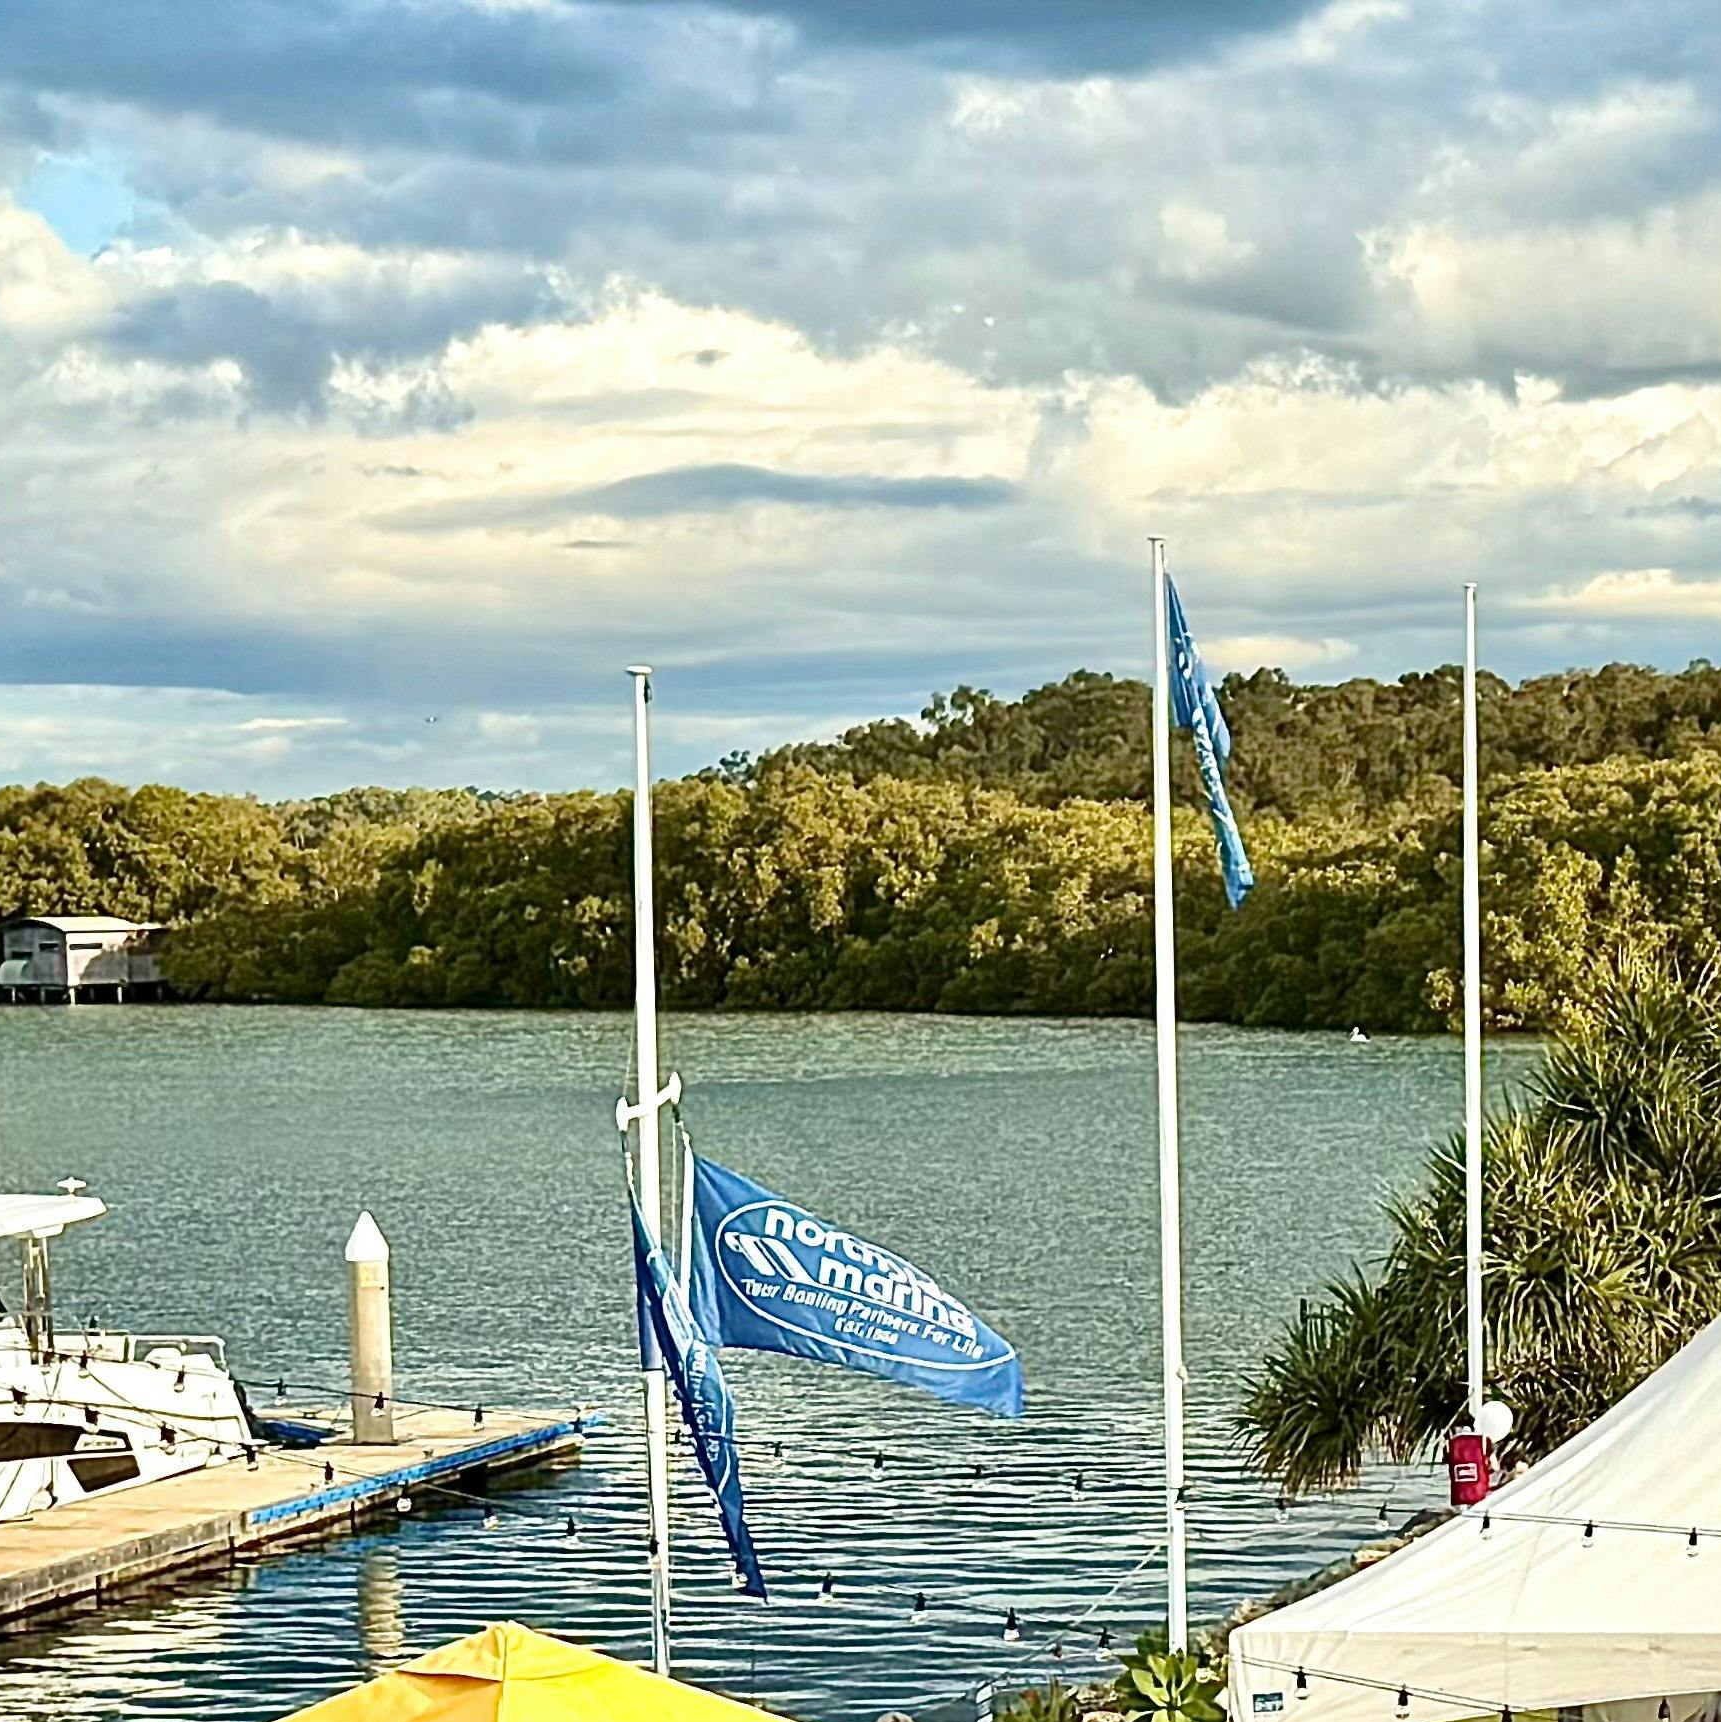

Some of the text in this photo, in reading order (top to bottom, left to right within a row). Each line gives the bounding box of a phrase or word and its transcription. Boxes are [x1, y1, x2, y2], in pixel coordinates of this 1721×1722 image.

[740, 1278, 781, 1299] Your
[782, 1283, 849, 1317] Boating
[848, 1299, 921, 1336] Partners
[921, 1323, 952, 1347] For
[951, 1334, 985, 1360] Life
[818, 1256, 977, 1340] marina
